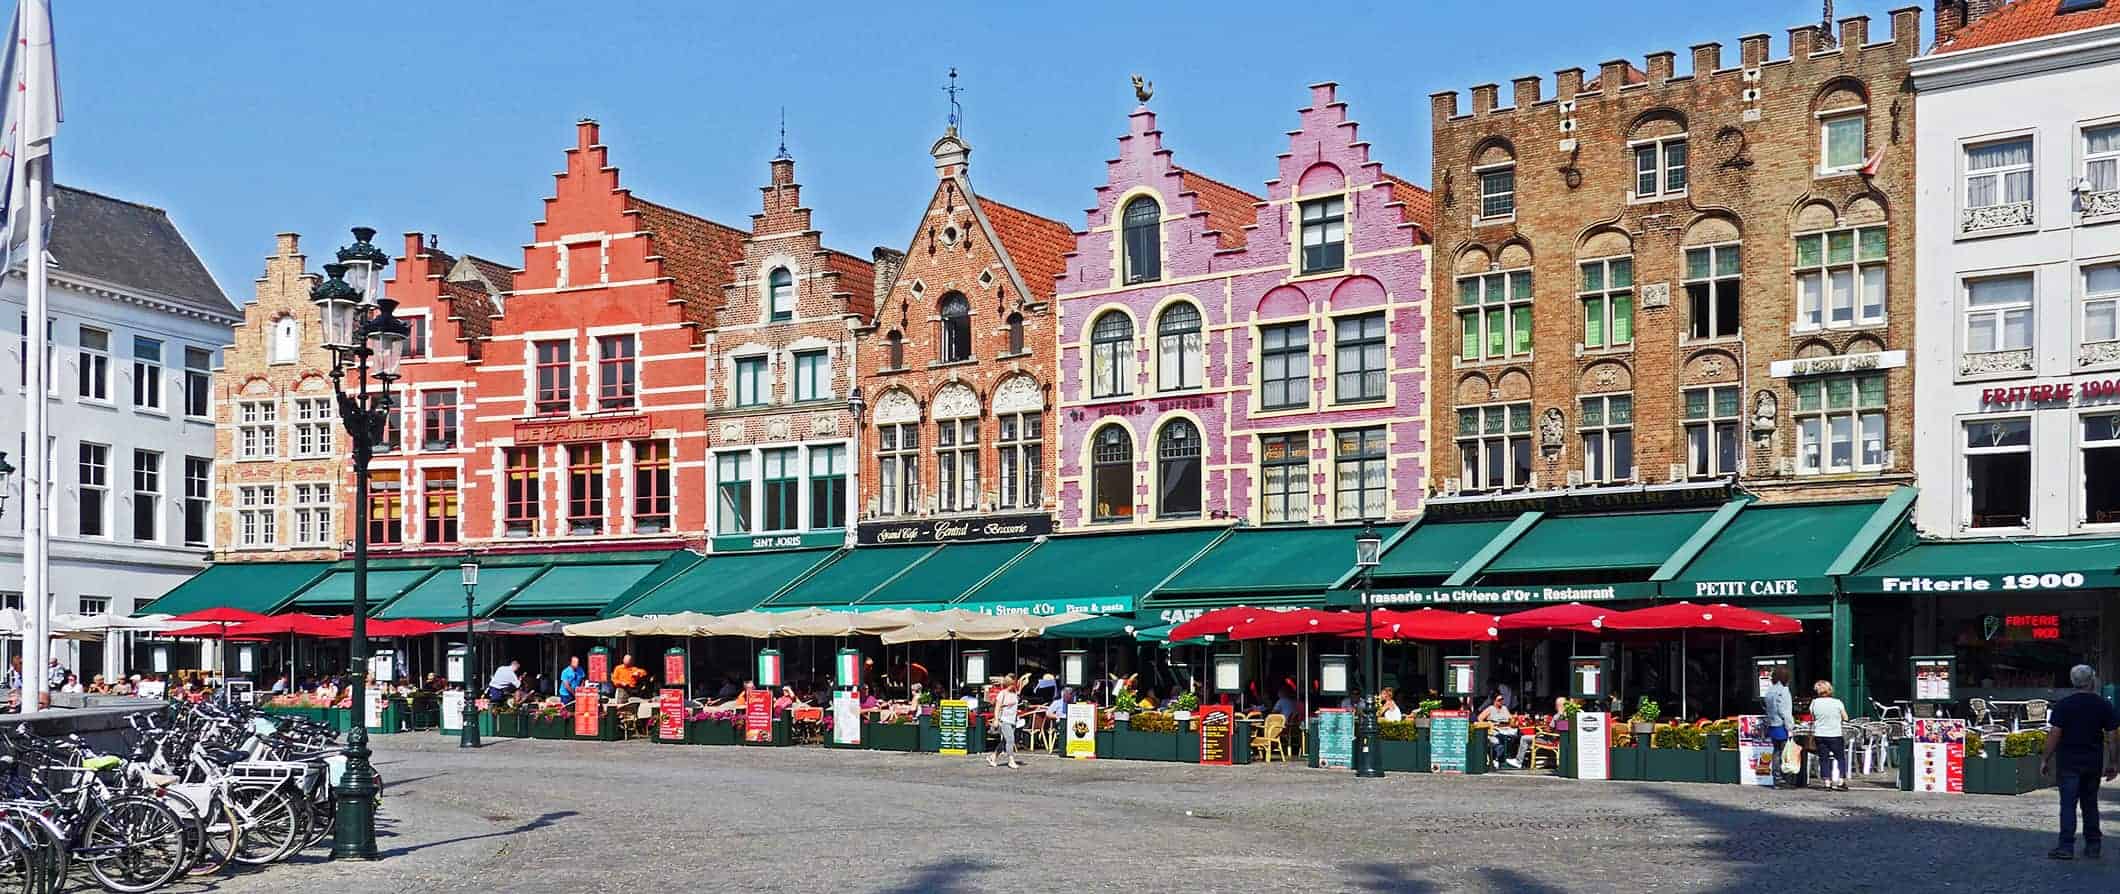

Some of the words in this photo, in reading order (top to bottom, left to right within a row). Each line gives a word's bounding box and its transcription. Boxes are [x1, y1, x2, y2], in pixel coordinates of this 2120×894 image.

[1981, 383, 2074, 405] FRITERIE
[934, 521, 969, 541] Central
[984, 522, 1028, 535] Brasserie
[752, 538, 774, 548] SINT
[775, 536, 801, 547] JORIS
[1695, 581, 1746, 596] PETIT
[1750, 580, 1799, 595] CAFE
[1881, 576, 1991, 592] Friterie
[2001, 573, 2085, 589] 1900
[1434, 591, 1450, 602] La
[1501, 589, 1530, 601] d'Or
[1543, 586, 1615, 601] Restaurant
[2004, 615, 2060, 627] FRITERIE
